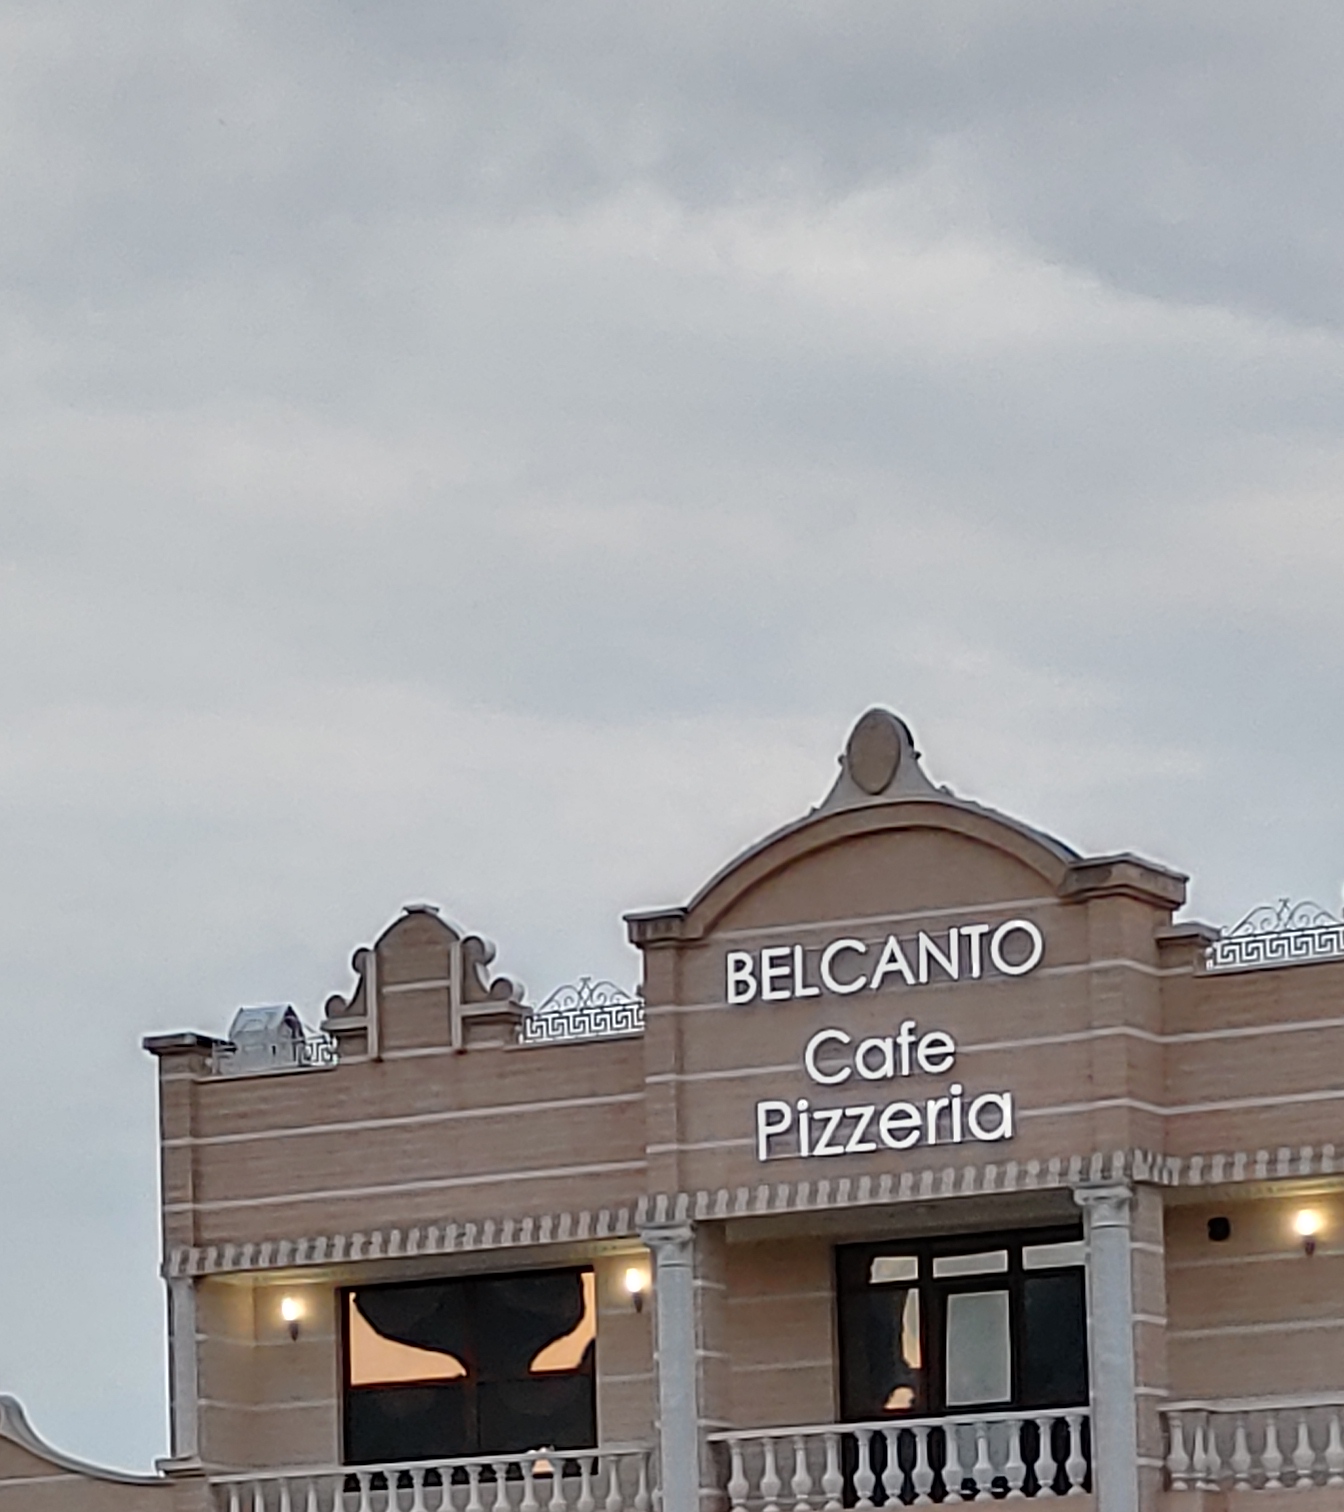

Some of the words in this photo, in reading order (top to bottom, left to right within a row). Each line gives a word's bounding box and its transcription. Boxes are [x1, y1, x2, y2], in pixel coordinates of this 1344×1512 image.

[727, 919, 1043, 1004] BELCANTO
[805, 1021, 955, 1084] Cafe
[758, 1084, 1013, 1161] Pizzeria
